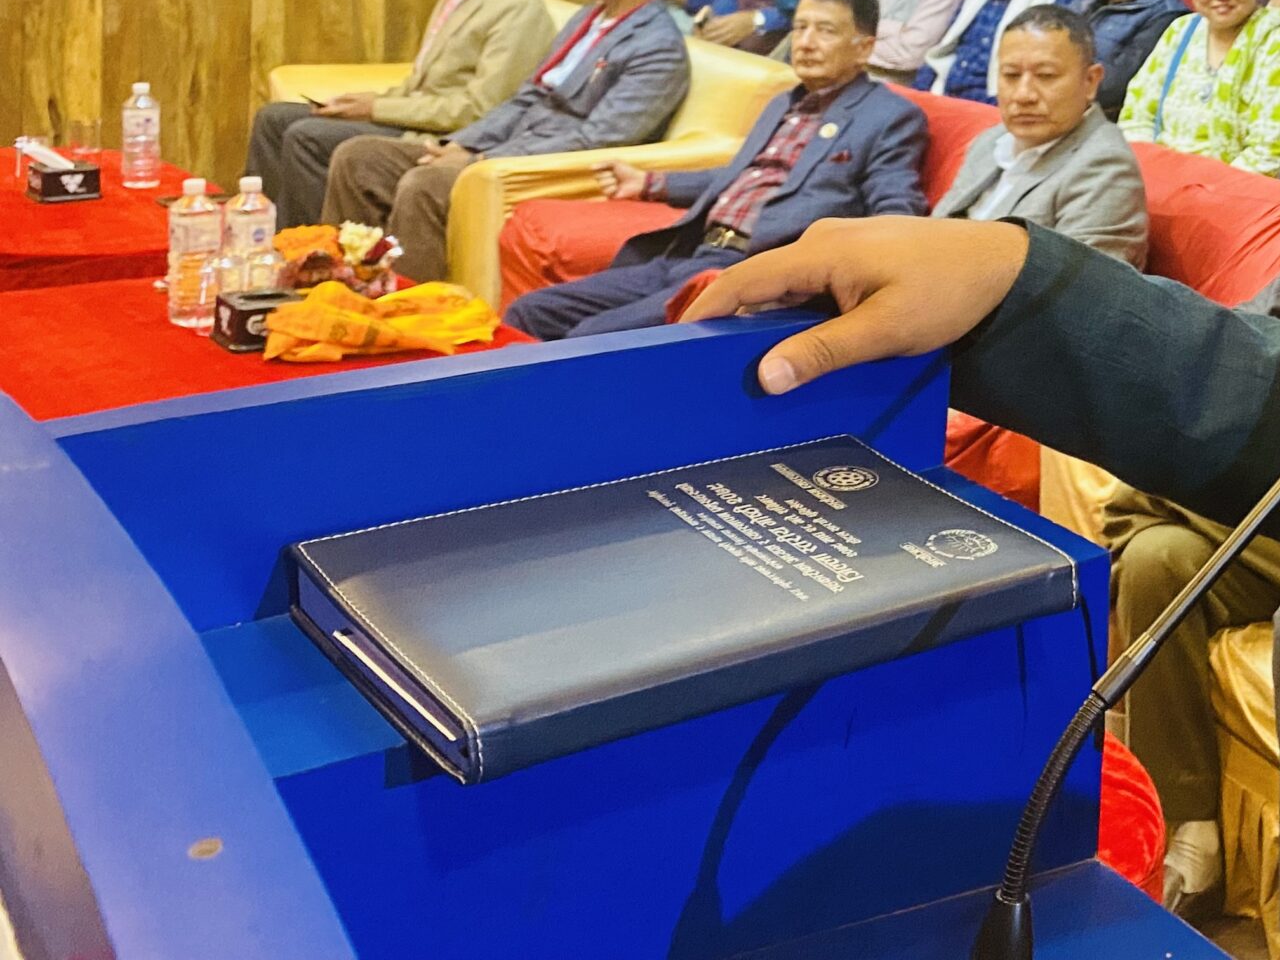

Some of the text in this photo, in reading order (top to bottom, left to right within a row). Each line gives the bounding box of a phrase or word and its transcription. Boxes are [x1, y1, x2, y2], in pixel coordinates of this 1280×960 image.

[733, 504, 776, 527] गोष्ठी
[769, 527, 817, 554] स्तरीय
[810, 554, 864, 582] जिल्ला
